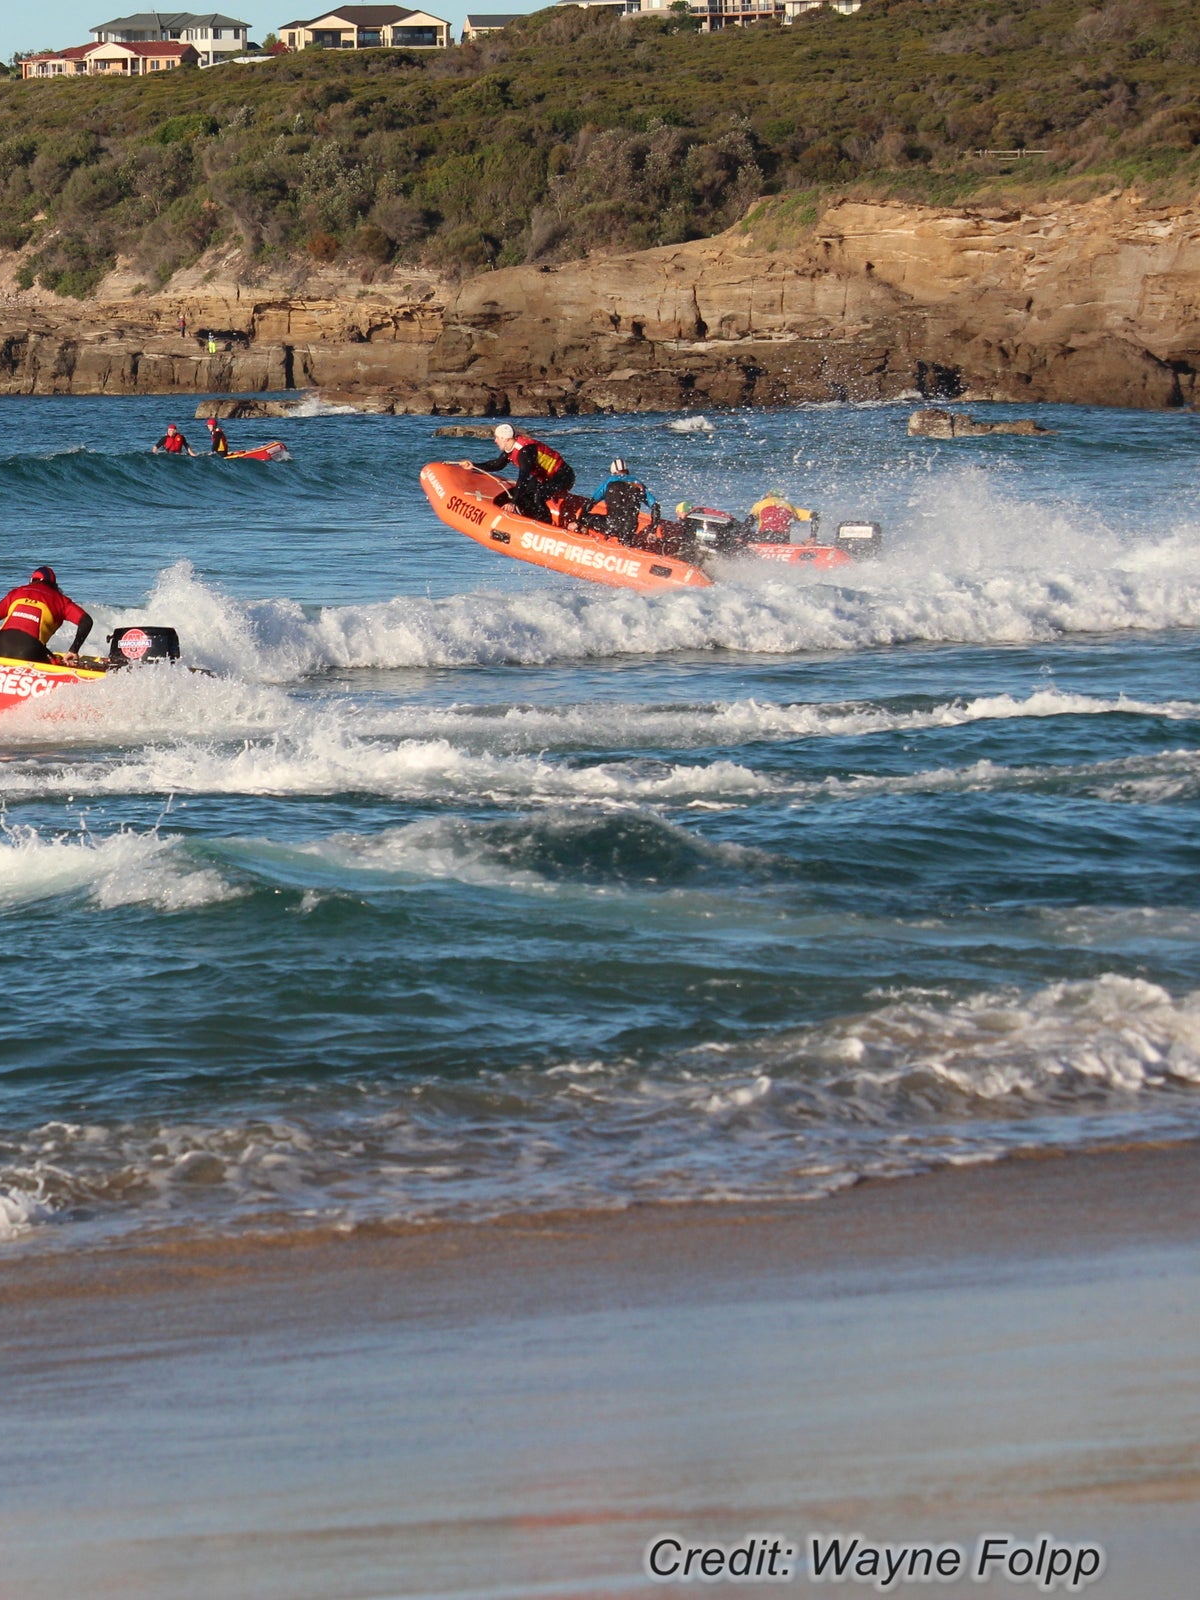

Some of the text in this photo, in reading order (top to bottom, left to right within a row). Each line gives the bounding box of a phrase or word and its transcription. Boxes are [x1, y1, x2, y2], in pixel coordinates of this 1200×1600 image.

[447, 496, 487, 525] SR1135N
[520, 532, 642, 578] SURF RESCUE
[13, 666, 47, 679] SLSC
